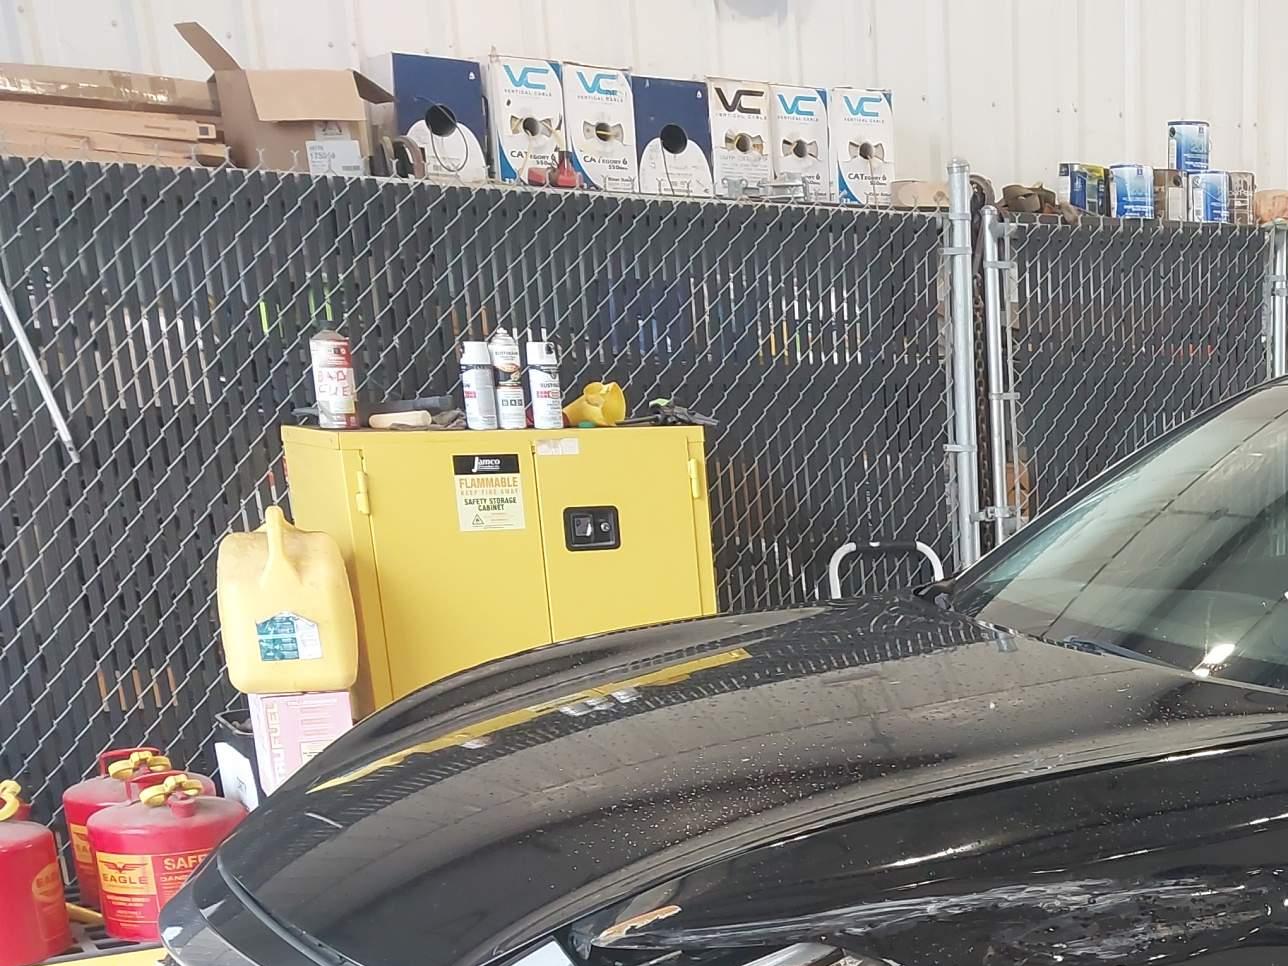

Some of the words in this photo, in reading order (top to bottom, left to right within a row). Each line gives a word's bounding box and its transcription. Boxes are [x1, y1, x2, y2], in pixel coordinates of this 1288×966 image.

[504, 65, 549, 90] VC
[576, 71, 619, 96] VC
[714, 87, 765, 115] VC
[777, 94, 817, 117] VC
[843, 95, 882, 117] VC
[472, 456, 501, 473] Jamco
[459, 476, 519, 489] FLAMMABLE
[464, 498, 487, 506] SAFETY
[489, 496, 517, 505] STORAGE
[478, 503, 505, 511] CABINET
[102, 873, 149, 884] EAGLE
